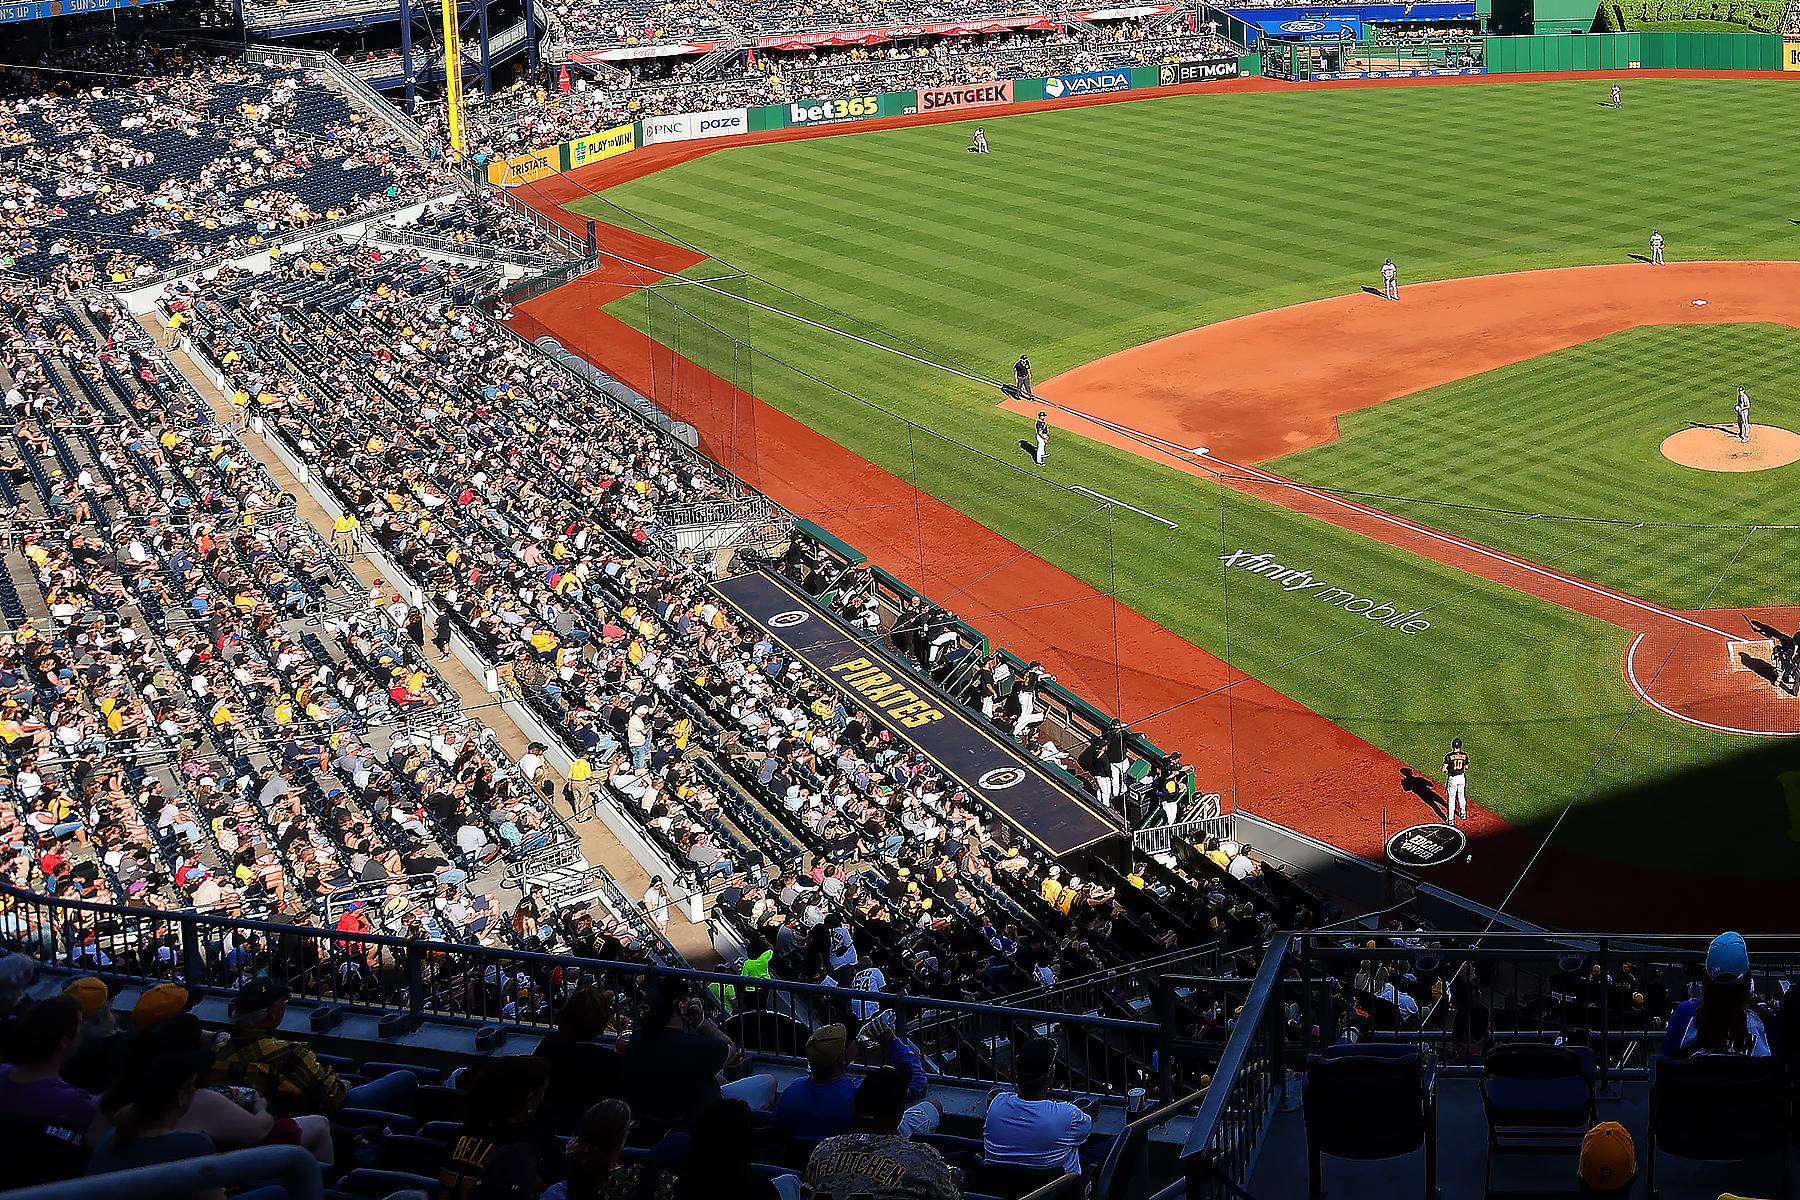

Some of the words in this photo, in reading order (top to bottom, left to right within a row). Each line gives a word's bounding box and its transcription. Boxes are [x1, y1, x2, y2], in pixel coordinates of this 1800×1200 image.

[16, 6, 29, 18] UP
[1180, 62, 1238, 81] BETMGM
[1066, 72, 1130, 93] VANDA
[922, 83, 1007, 109] SEATGEEK
[789, 96, 879, 123] bet365
[655, 122, 683, 135] PNC
[700, 116, 741, 132] paze
[588, 140, 608, 156] PLAY
[614, 131, 633, 148] WIN!
[511, 156, 549, 177] TRISTATE
[1217, 548, 1327, 592] xfinity
[1312, 585, 1432, 635] mobile
[829, 656, 946, 730] PIRATES
[1453, 758, 1465, 770] 10
[451, 1133, 496, 1169] BELL
